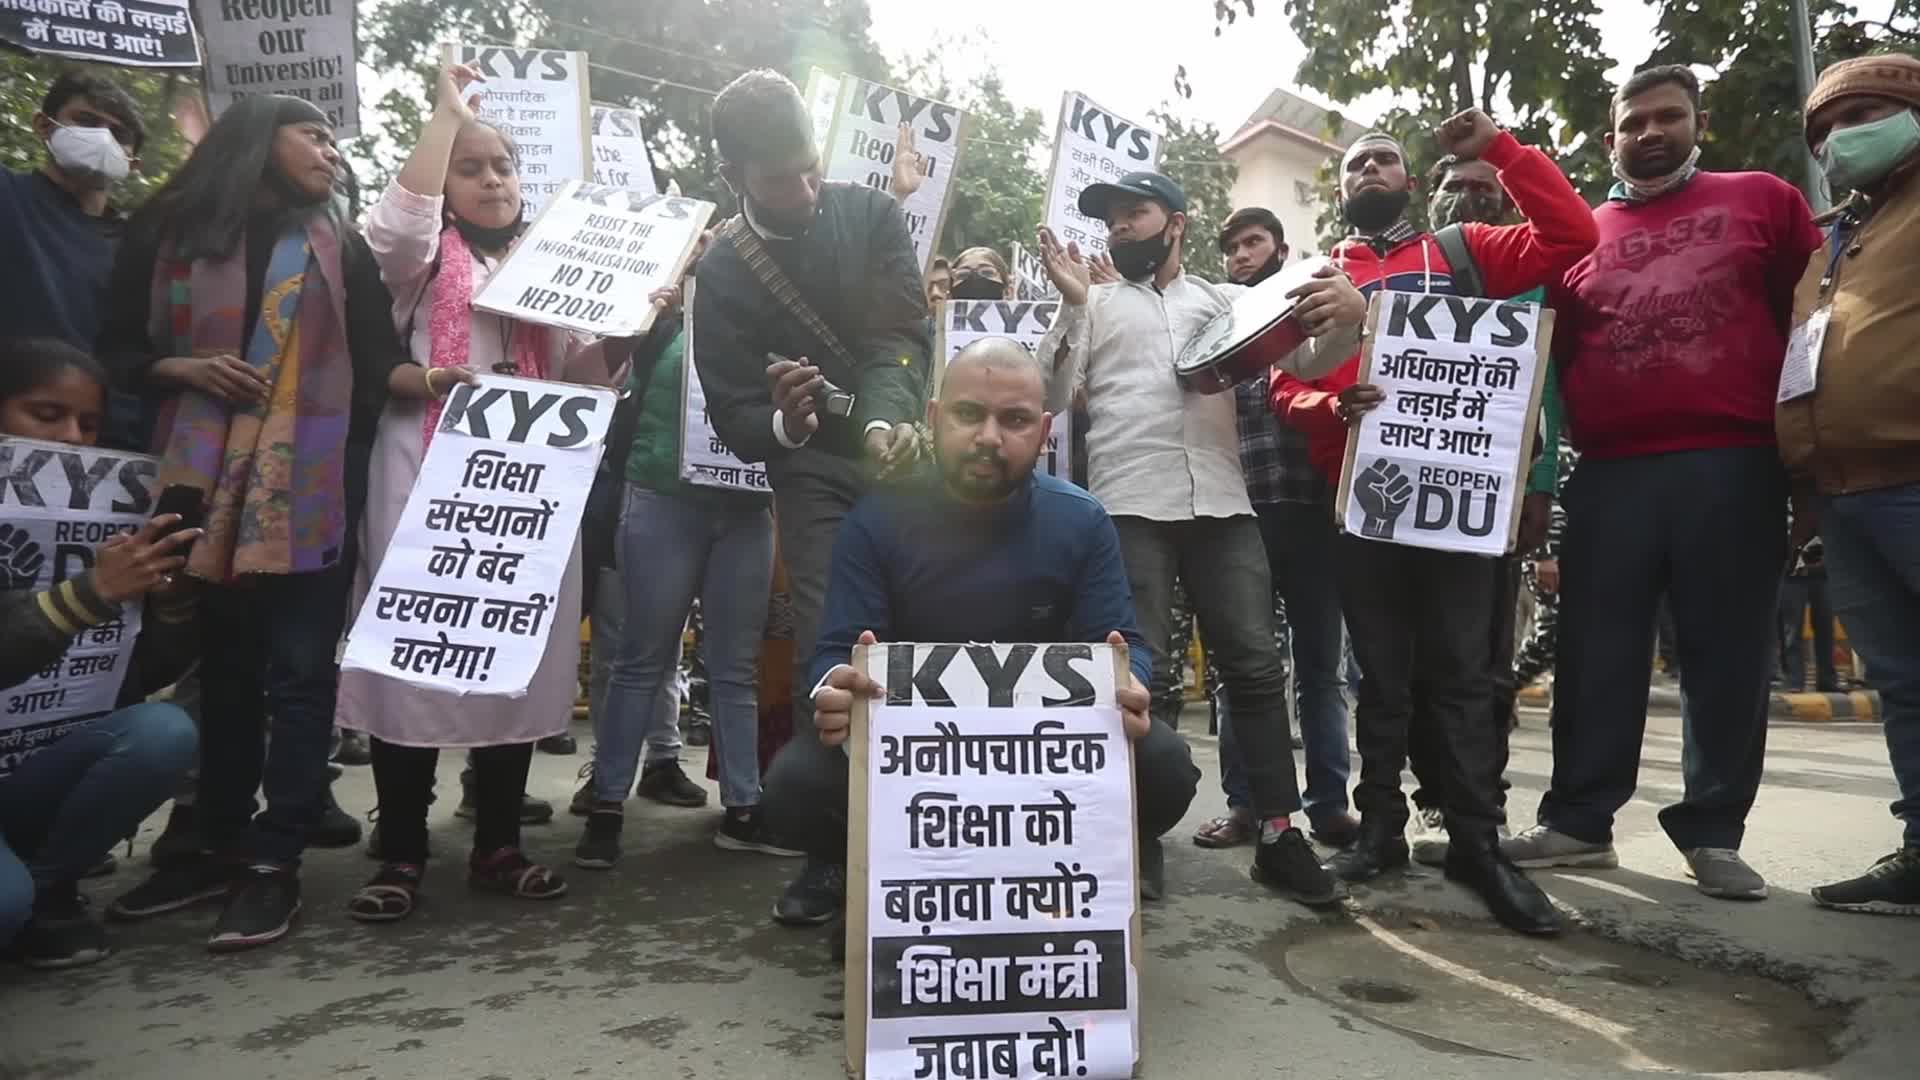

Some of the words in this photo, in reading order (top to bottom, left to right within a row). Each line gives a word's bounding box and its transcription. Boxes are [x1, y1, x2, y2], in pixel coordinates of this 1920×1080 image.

[22, 17, 50, 42] में
[52, 25, 106, 49] साथ
[93, 1, 125, 25] की
[128, 9, 187, 36] लड़ाई
[259, 28, 306, 55] our
[462, 46, 568, 81] KYS
[226, 55, 343, 86] University!
[849, 79, 957, 142] KYS
[1070, 98, 1152, 161] KYS
[571, 229, 626, 251] AGENDA
[627, 240, 646, 255] OF
[585, 213, 628, 233] RESIST
[629, 221, 655, 239] THE
[535, 239, 659, 277] INFORMALISATION!
[550, 263, 583, 287] NO
[585, 270, 614, 294] TO
[516, 286, 615, 324] NEP2020!
[953, 301, 1059, 335] KYS
[1387, 293, 1531, 347] KYS
[1379, 349, 1486, 387] अधिकारों
[1484, 357, 1520, 390] की
[439, 384, 598, 448] KYS
[1396, 388, 1460, 423] लड़ाई
[1463, 390, 1493, 422] में
[1380, 422, 1434, 450] साथ
[1437, 427, 1492, 458] आएं!
[0, 447, 158, 513] KYS
[461, 449, 546, 494] शिक्षा
[1419, 466, 1501, 492] REOPEN
[425, 492, 559, 541] संस्थानों
[1414, 484, 1497, 537] DU
[427, 538, 475, 579] को
[476, 542, 524, 584] बंद
[376, 586, 478, 629] रखना
[481, 593, 555, 636] नहीं
[69, 654, 118, 677] साथ
[390, 632, 496, 681] चलेगा!
[886, 644, 1096, 707] KYS
[880, 721, 1109, 776] अनौपचारिक
[906, 792, 1015, 848] शिक्षा
[1021, 790, 1076, 845] को
[881, 877, 995, 935] बढ़ावा
[1002, 862, 1099, 919] क्यों?
[897, 945, 1010, 1005] शिक्षा
[1015, 942, 1102, 999] मंत्री
[908, 1033, 1022, 1080] जवाब
[1027, 1017, 1086, 1080] दो!
